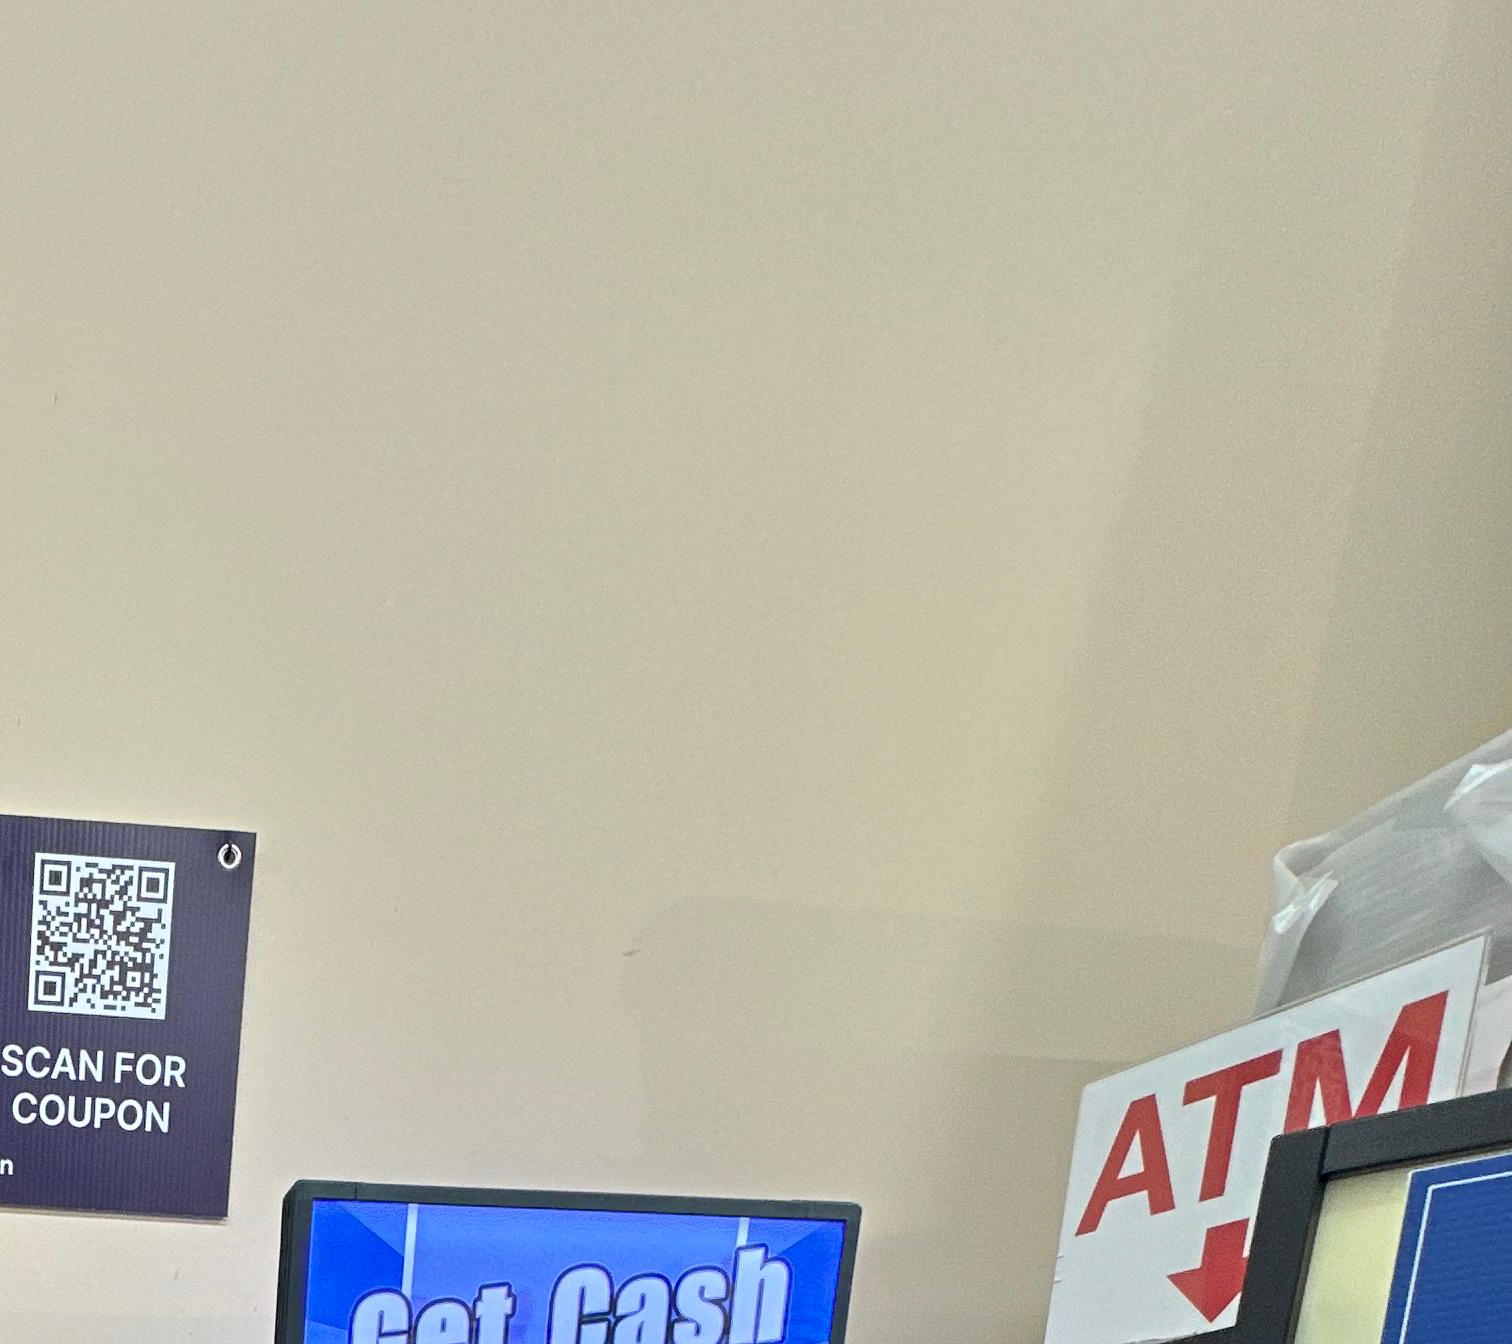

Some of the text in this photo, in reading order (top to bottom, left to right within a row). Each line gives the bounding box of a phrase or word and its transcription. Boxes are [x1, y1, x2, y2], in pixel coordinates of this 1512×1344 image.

[0, 1044, 187, 1089] SCAN FOR
[11, 1092, 171, 1134] COUPON
[1074, 990, 1450, 1237] ATM
